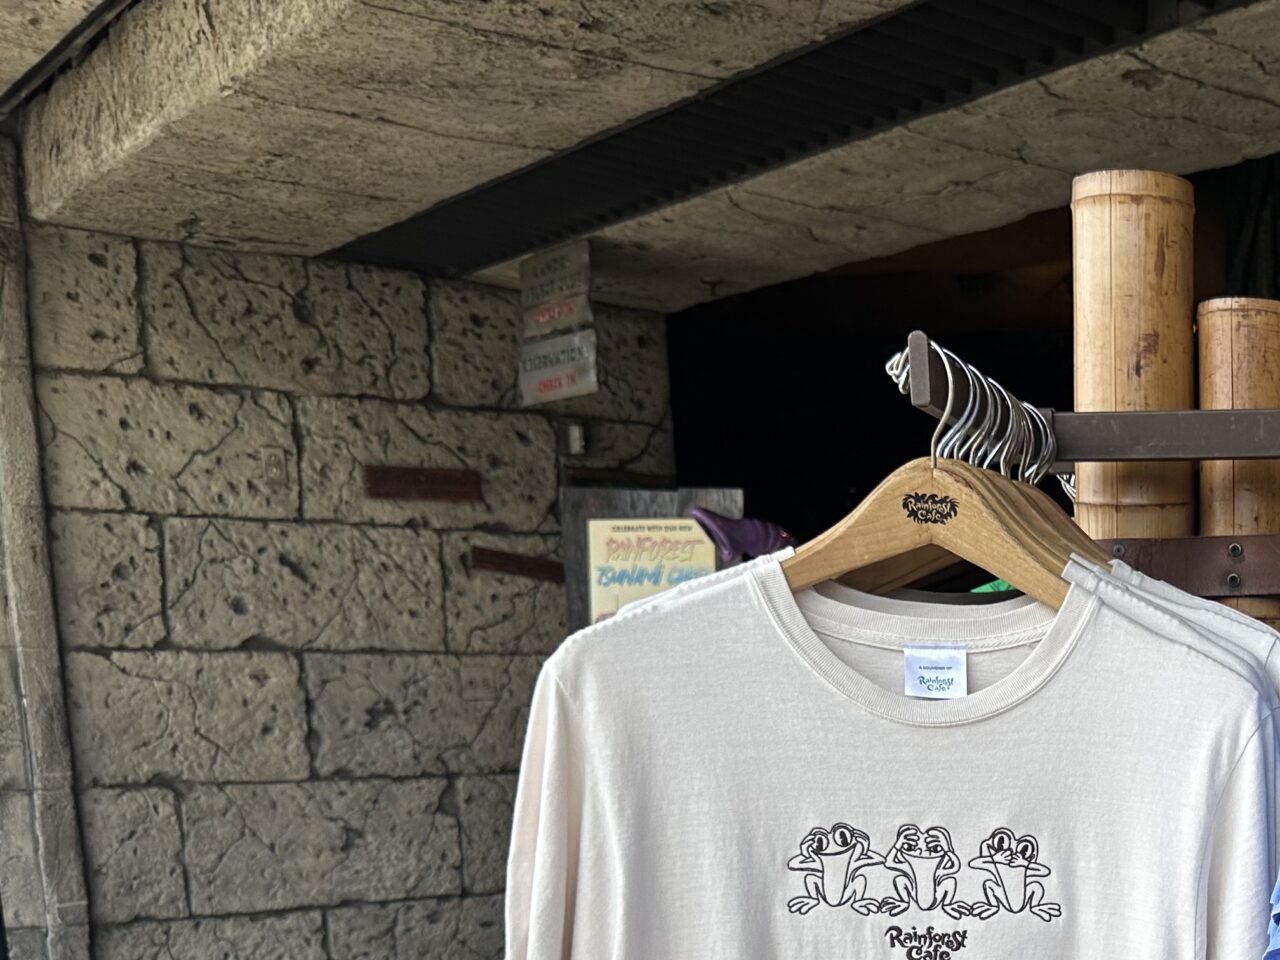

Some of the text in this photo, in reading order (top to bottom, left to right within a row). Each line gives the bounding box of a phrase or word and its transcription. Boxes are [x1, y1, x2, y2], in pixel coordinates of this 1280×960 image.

[906, 498, 951, 514] Rainforest
[917, 509, 941, 521] Cafe
[606, 536, 704, 563] RAINFOREST
[884, 925, 968, 952] Rainforest
